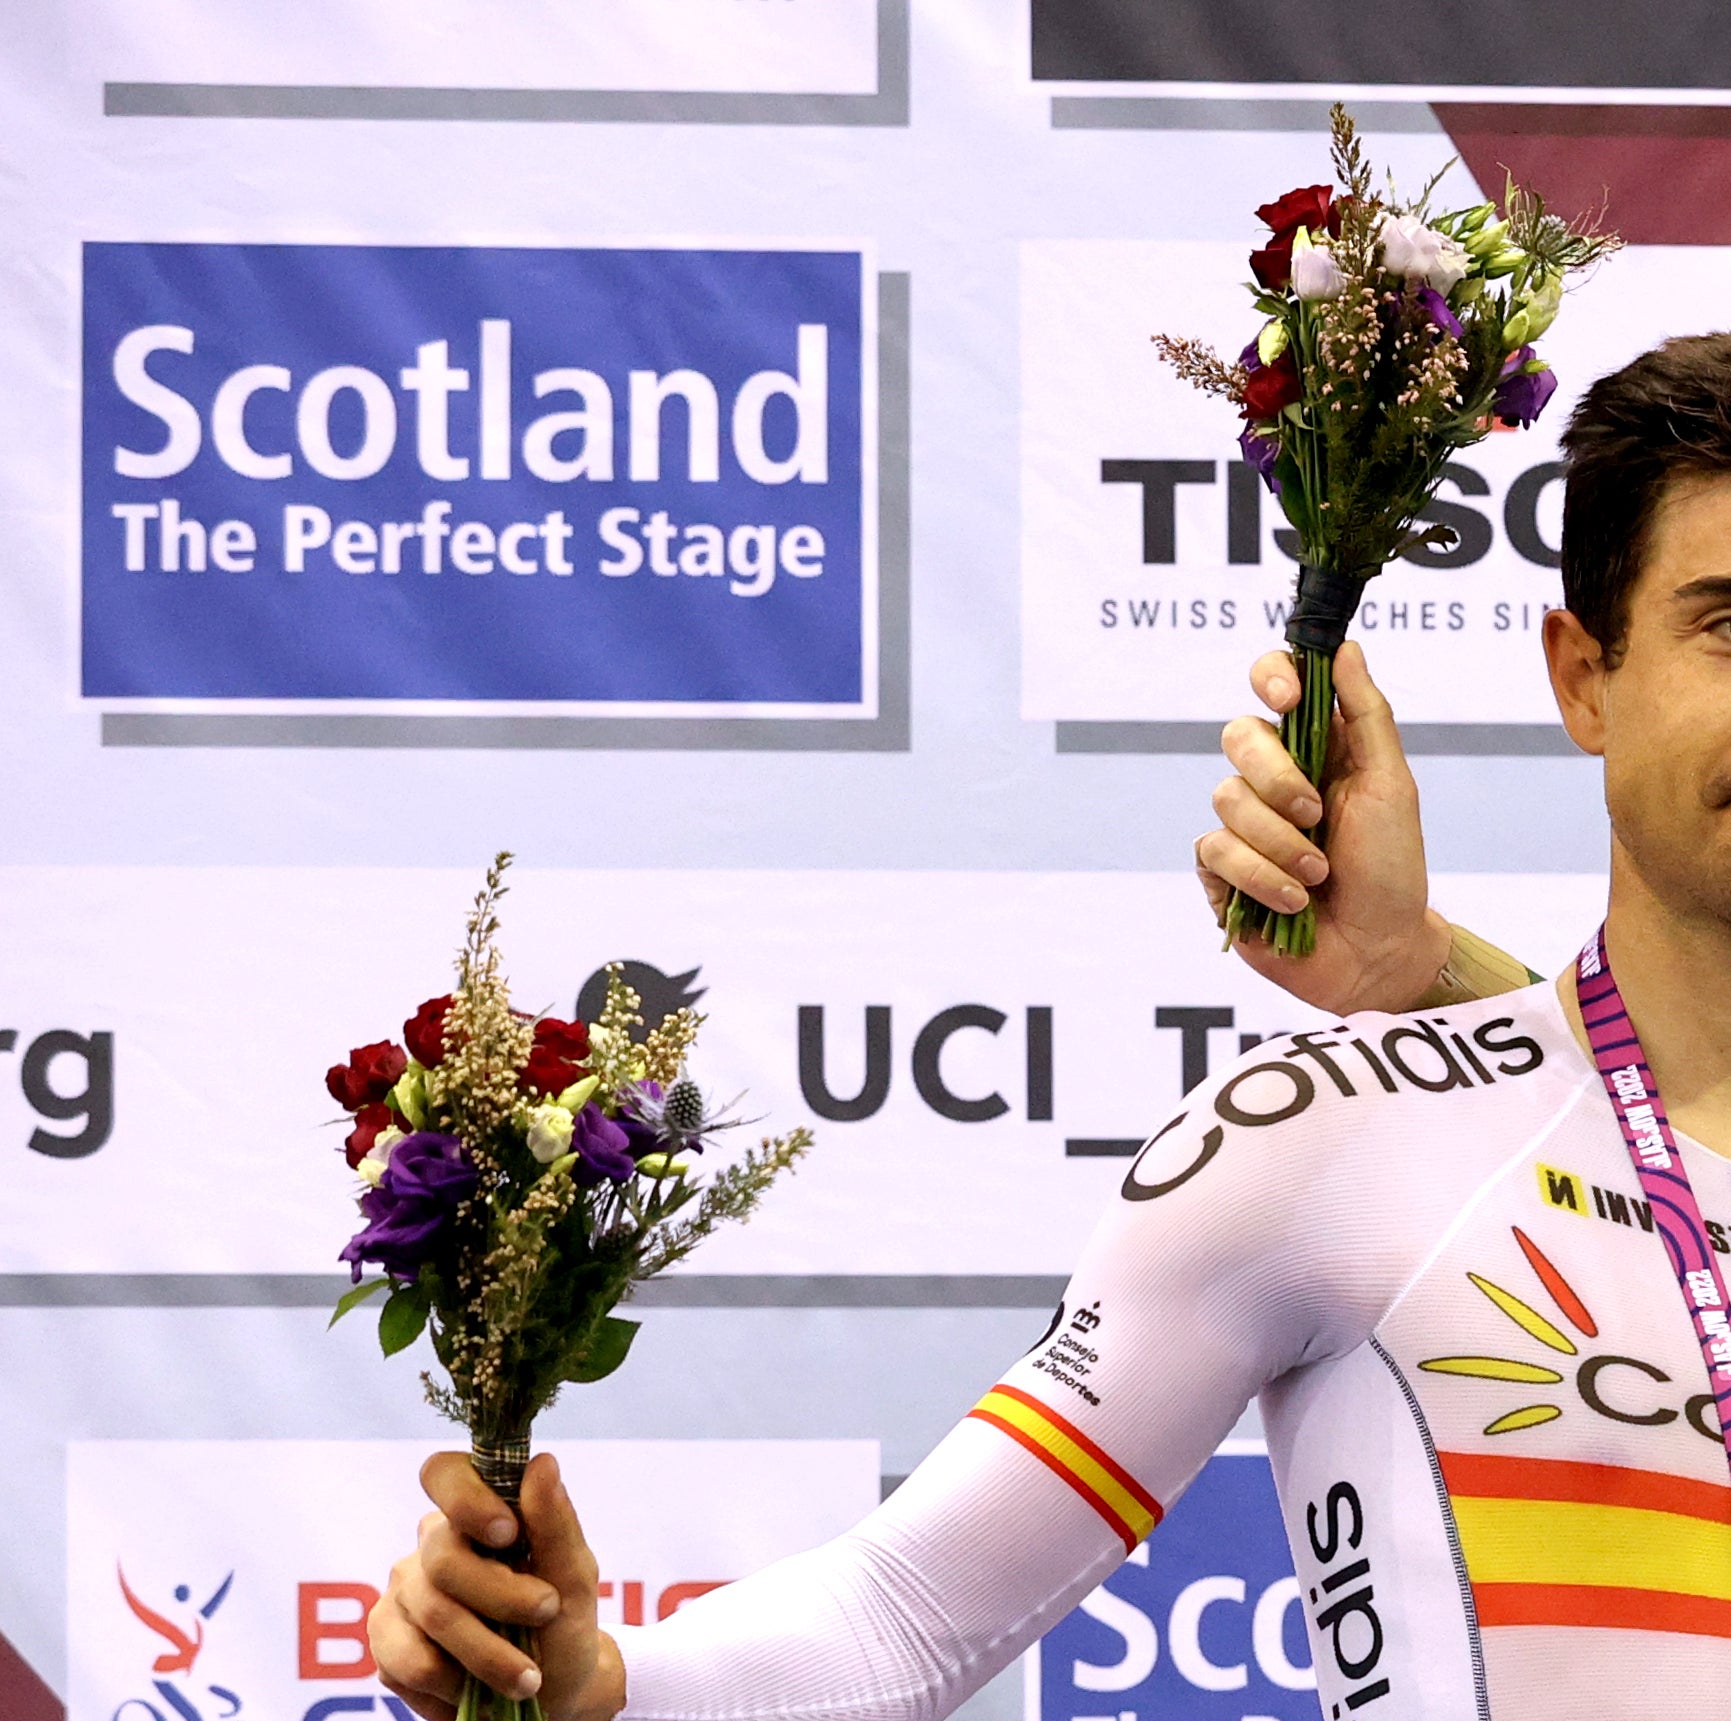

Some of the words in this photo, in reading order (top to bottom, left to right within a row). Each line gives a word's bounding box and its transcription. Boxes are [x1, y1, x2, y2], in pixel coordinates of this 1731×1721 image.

[111, 319, 829, 485] Scotland
[112, 498, 257, 573] The
[283, 500, 574, 578] Perfect
[598, 508, 826, 598] Stage
[1100, 459, 1567, 569] TISO
[1100, 599, 1239, 629] SWISS
[1264, 601, 1467, 631] WCHES
[1121, 1016, 1544, 1202] Cofidis
